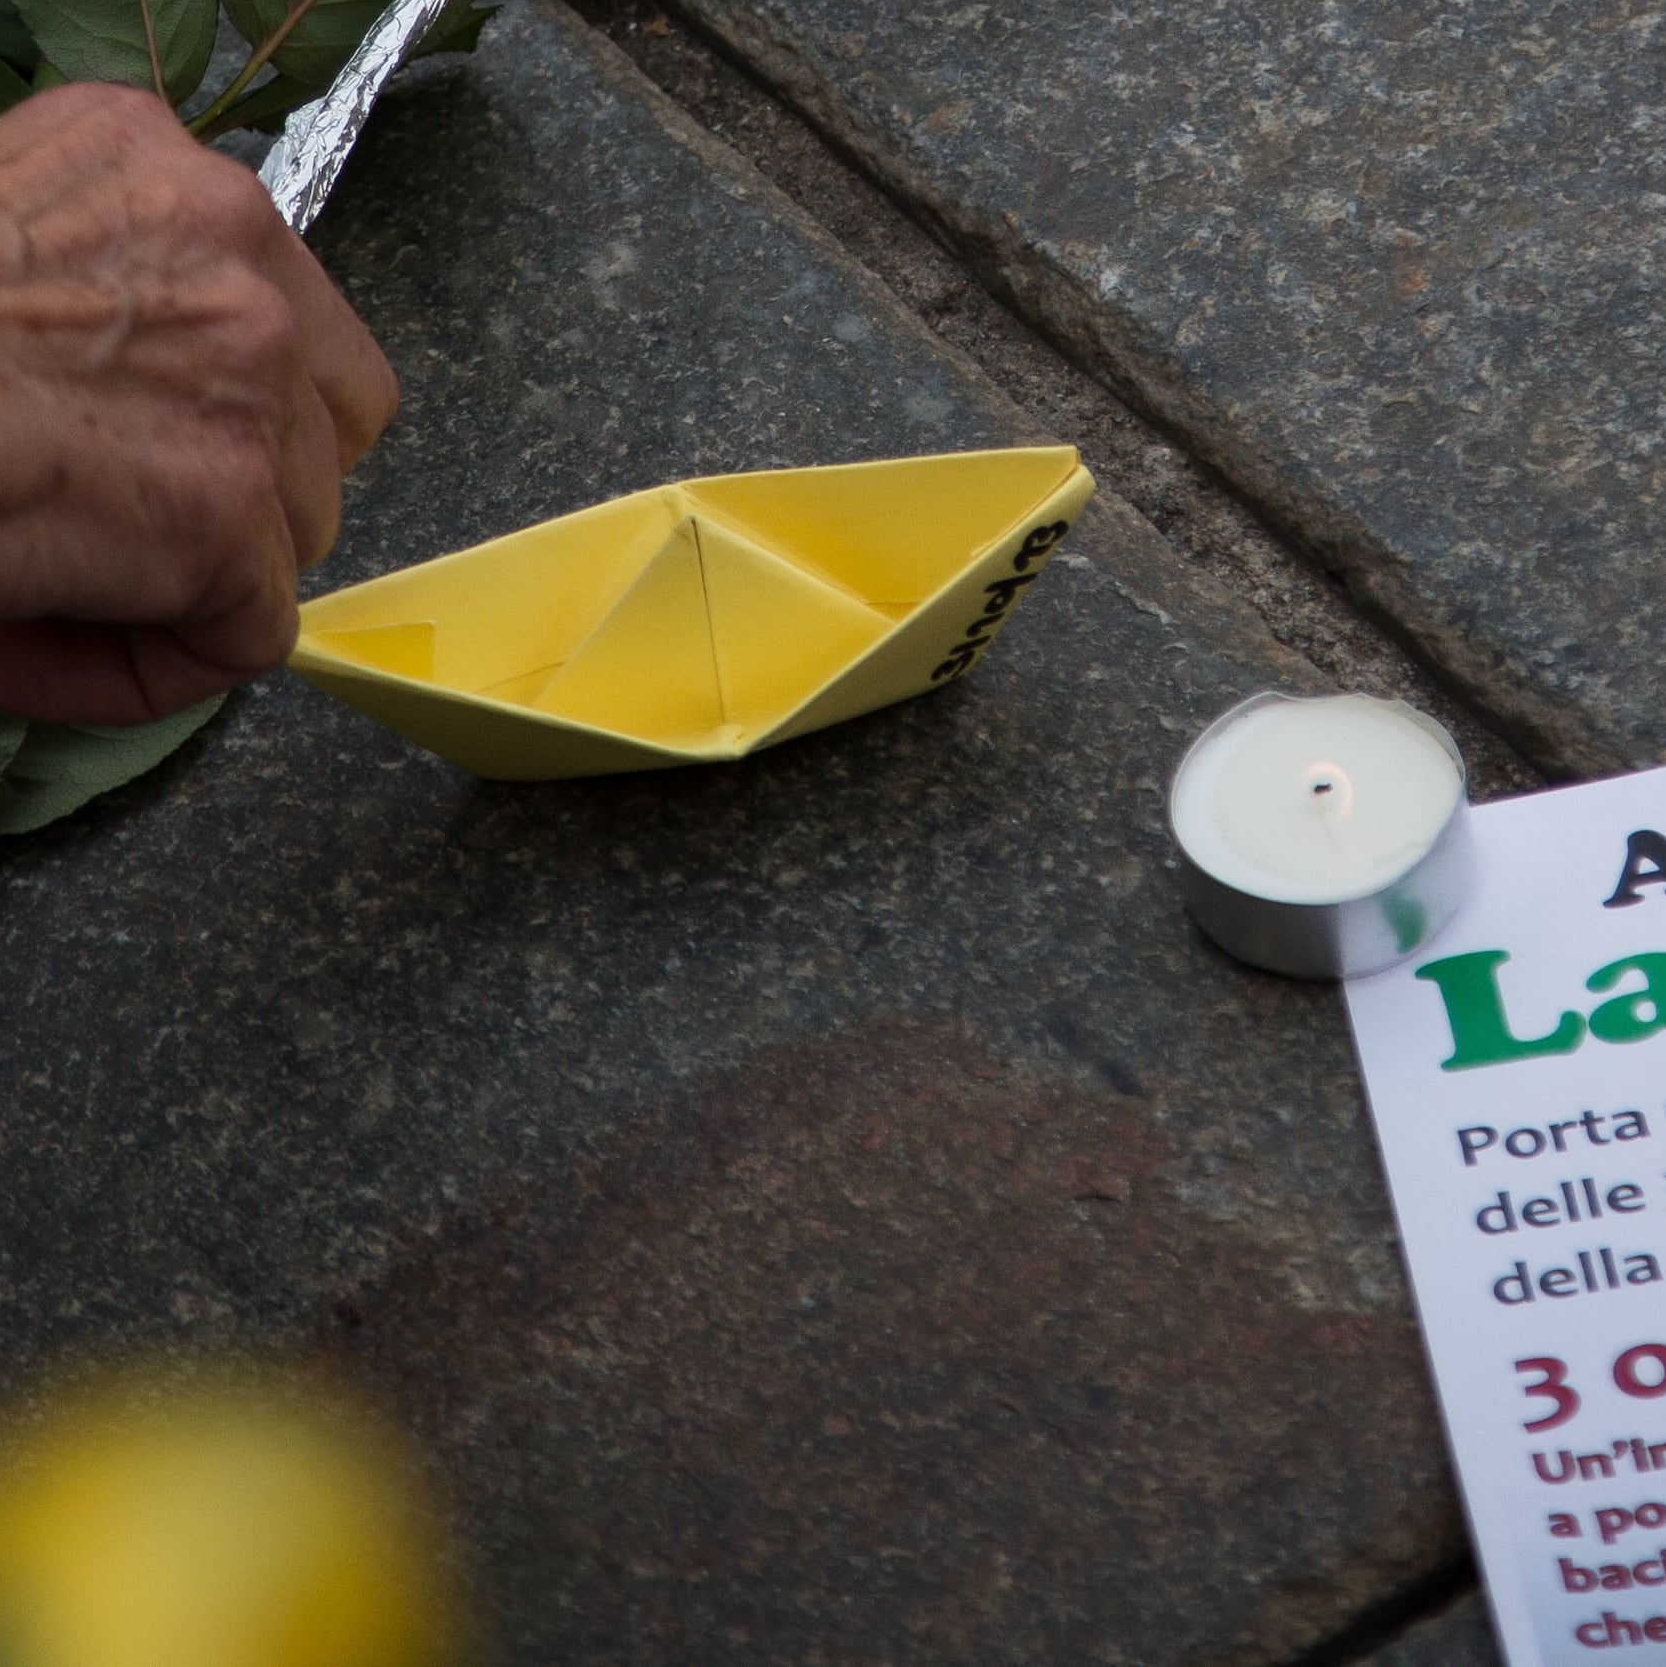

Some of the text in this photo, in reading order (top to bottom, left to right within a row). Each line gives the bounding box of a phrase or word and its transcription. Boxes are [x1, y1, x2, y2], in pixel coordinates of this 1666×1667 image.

[1456, 1109, 1650, 1166] Porta
[1475, 1177, 1645, 1235] delle
[1492, 1246, 1661, 1305] della
[1514, 1356, 1580, 1433] 3
[1548, 1513, 1579, 1537] a
